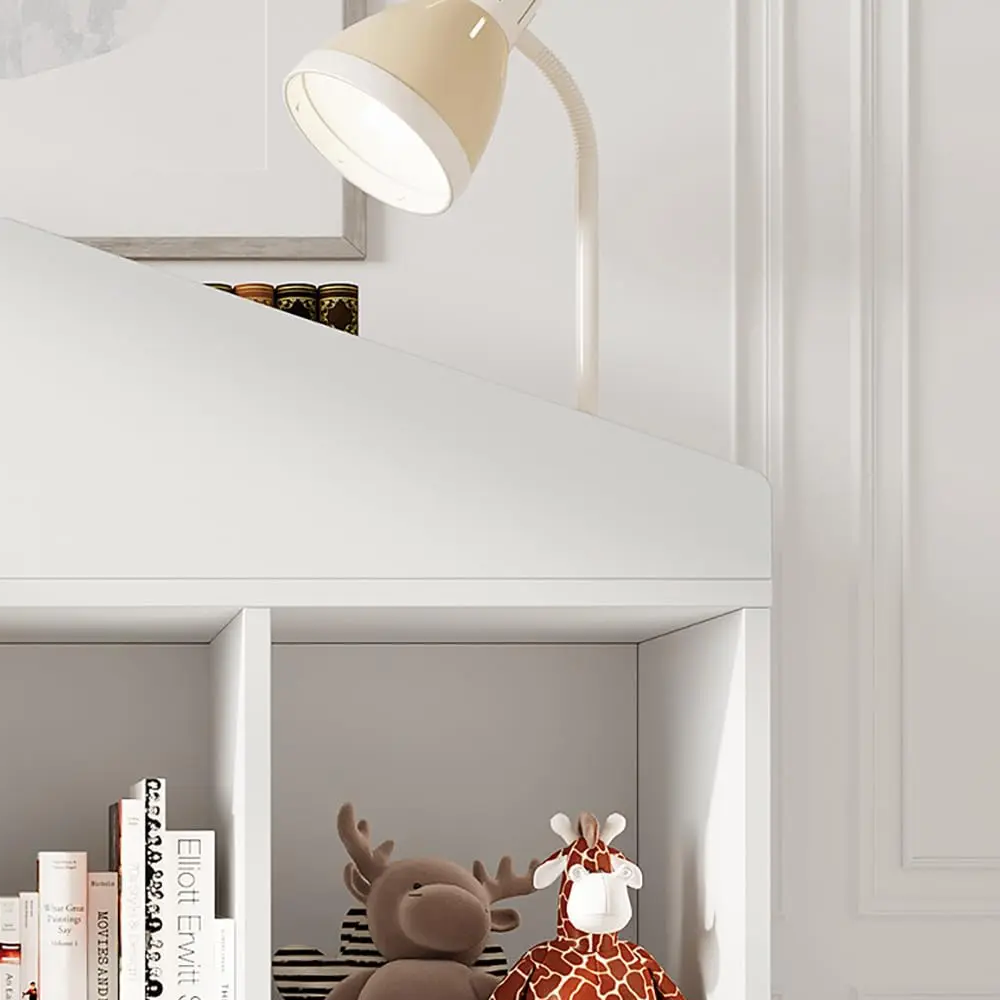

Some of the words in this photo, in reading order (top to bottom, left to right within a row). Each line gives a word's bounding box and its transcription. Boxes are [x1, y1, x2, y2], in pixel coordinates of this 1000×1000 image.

[177, 838, 202, 904] Elliott
[97, 911, 109, 965] MOVIES
[177, 915, 202, 985] Erwitt
[5, 972, 14, 986] An
[97, 967, 109, 996] AND
